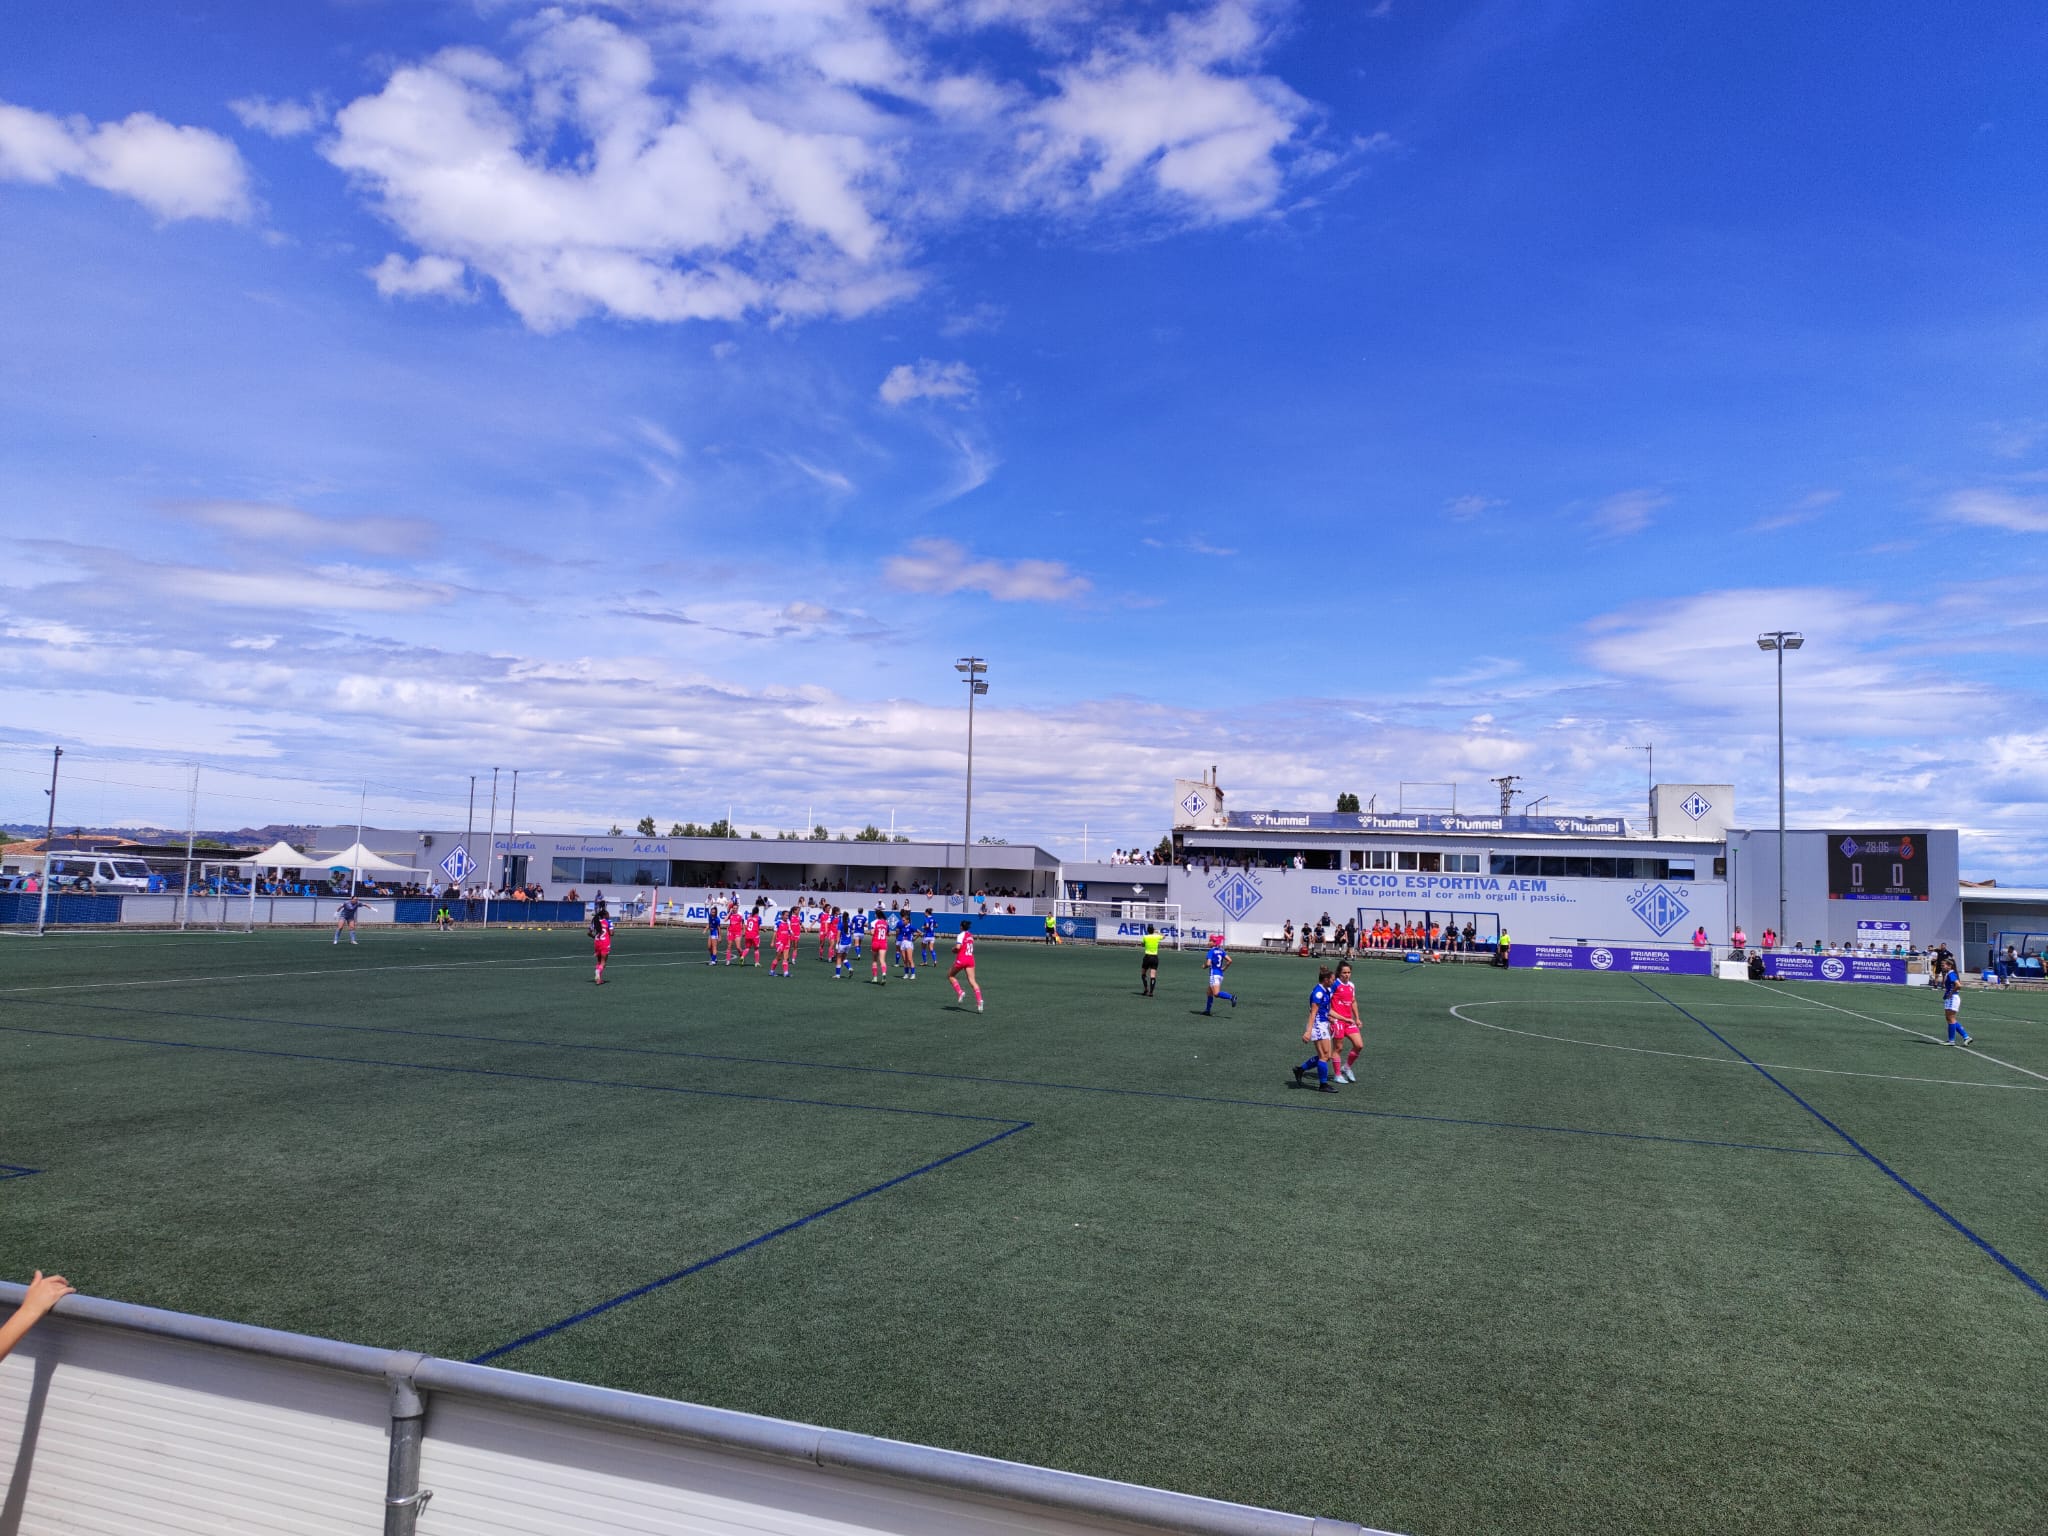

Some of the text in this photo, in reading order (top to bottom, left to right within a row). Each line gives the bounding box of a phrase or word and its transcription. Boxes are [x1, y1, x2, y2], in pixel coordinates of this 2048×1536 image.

[1265, 815, 1310, 826] hummel
[1373, 816, 1419, 829] hummel
[1456, 818, 1503, 830] hummel
[1570, 819, 1619, 833] hummel
[1852, 863, 1862, 886] 0
[1892, 863, 1903, 887] 0
[1405, 876, 1501, 891] ESPORTIVA
[1508, 879, 1548, 892] AEM
[1311, 885, 1340, 895] Blanc
[1352, 887, 1374, 897] blau
[1378, 888, 1417, 900] portem
[1421, 889, 1431, 899] al
[1435, 891, 1454, 900] cor
[1457, 890, 1481, 901] amb
[1485, 892, 1518, 903] orgull
[747, 921, 754, 932] 9
[1191, 926, 1207, 939] tu
[877, 928, 886, 940] 19
[1216, 954, 1223, 968] 3
